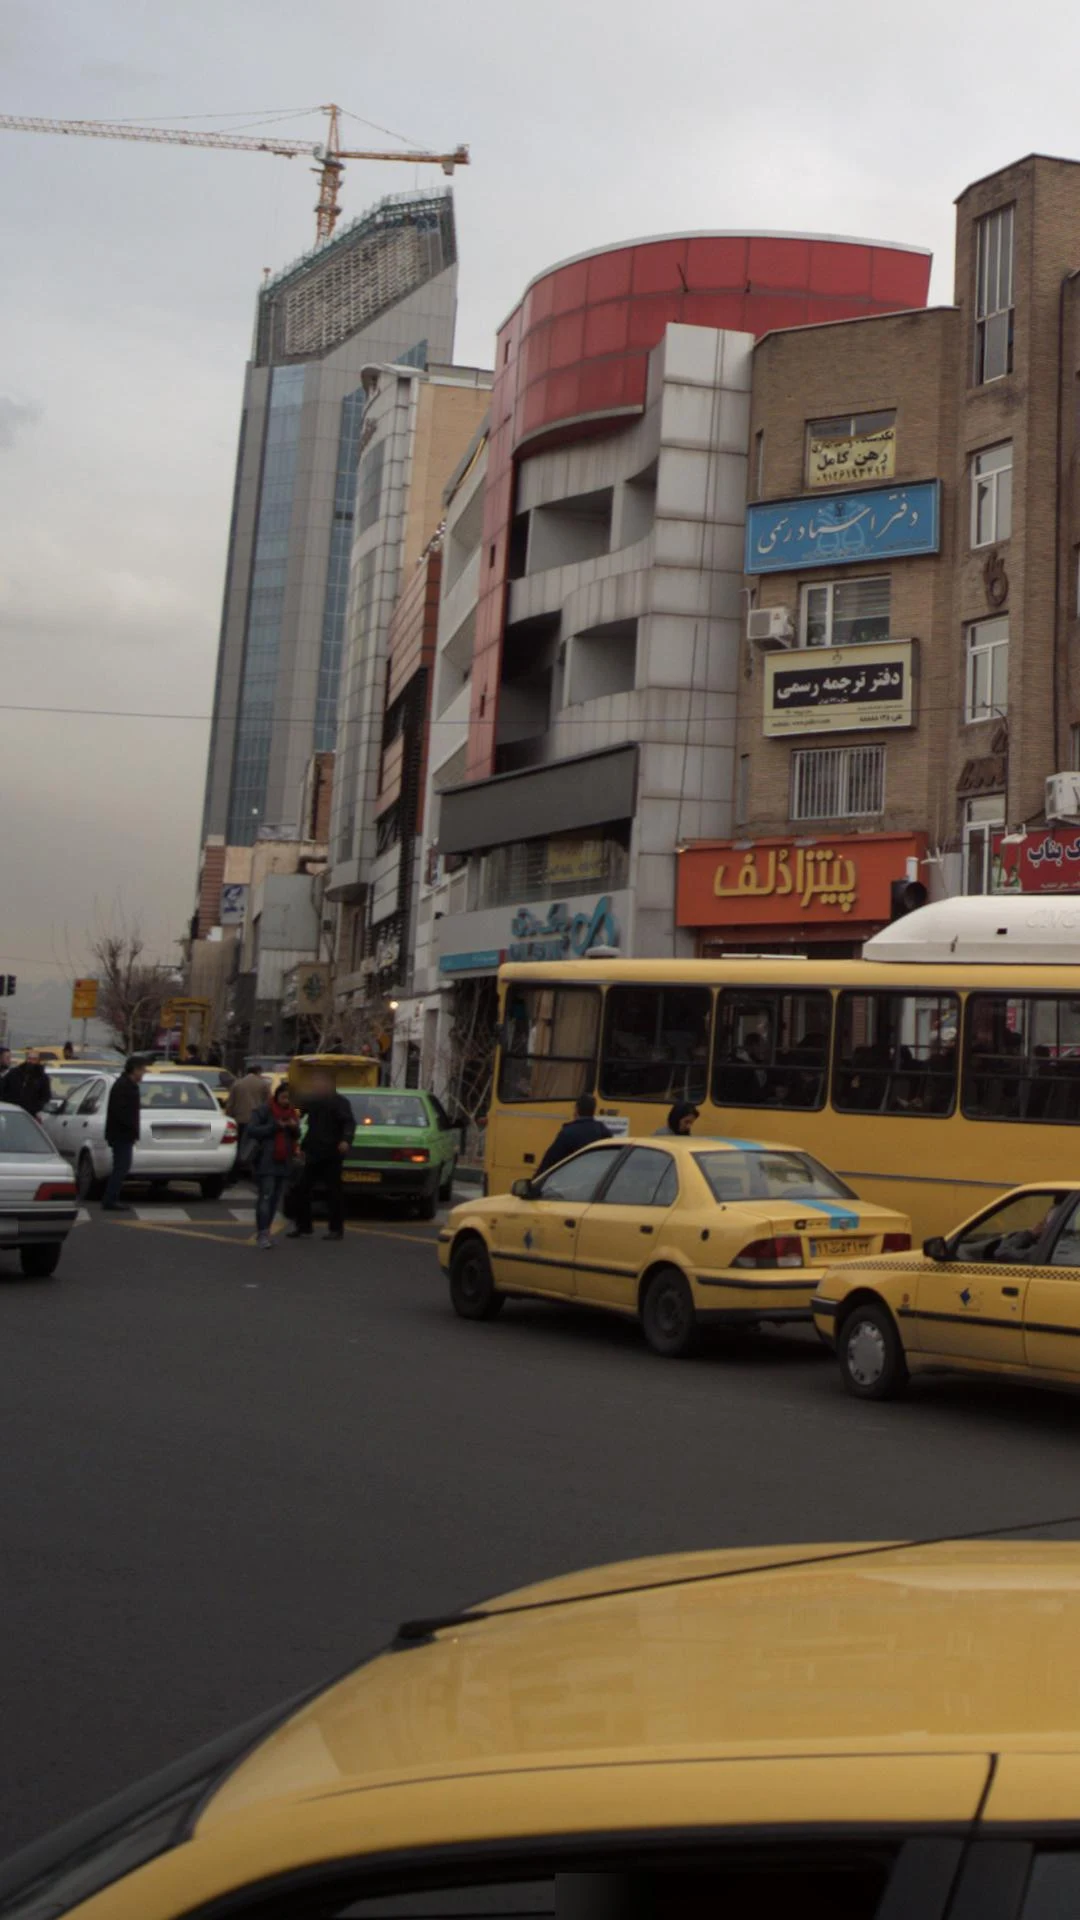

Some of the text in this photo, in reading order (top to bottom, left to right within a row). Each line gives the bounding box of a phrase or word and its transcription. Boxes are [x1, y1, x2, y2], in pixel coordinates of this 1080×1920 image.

[817, 451, 888, 470] رهن کامل
[874, 492, 919, 539] دفتر
[757, 517, 793, 554] رسمی
[776, 667, 901, 700] دفتر ترجمه رسمی
[795, 848, 856, 912] پیتزا
